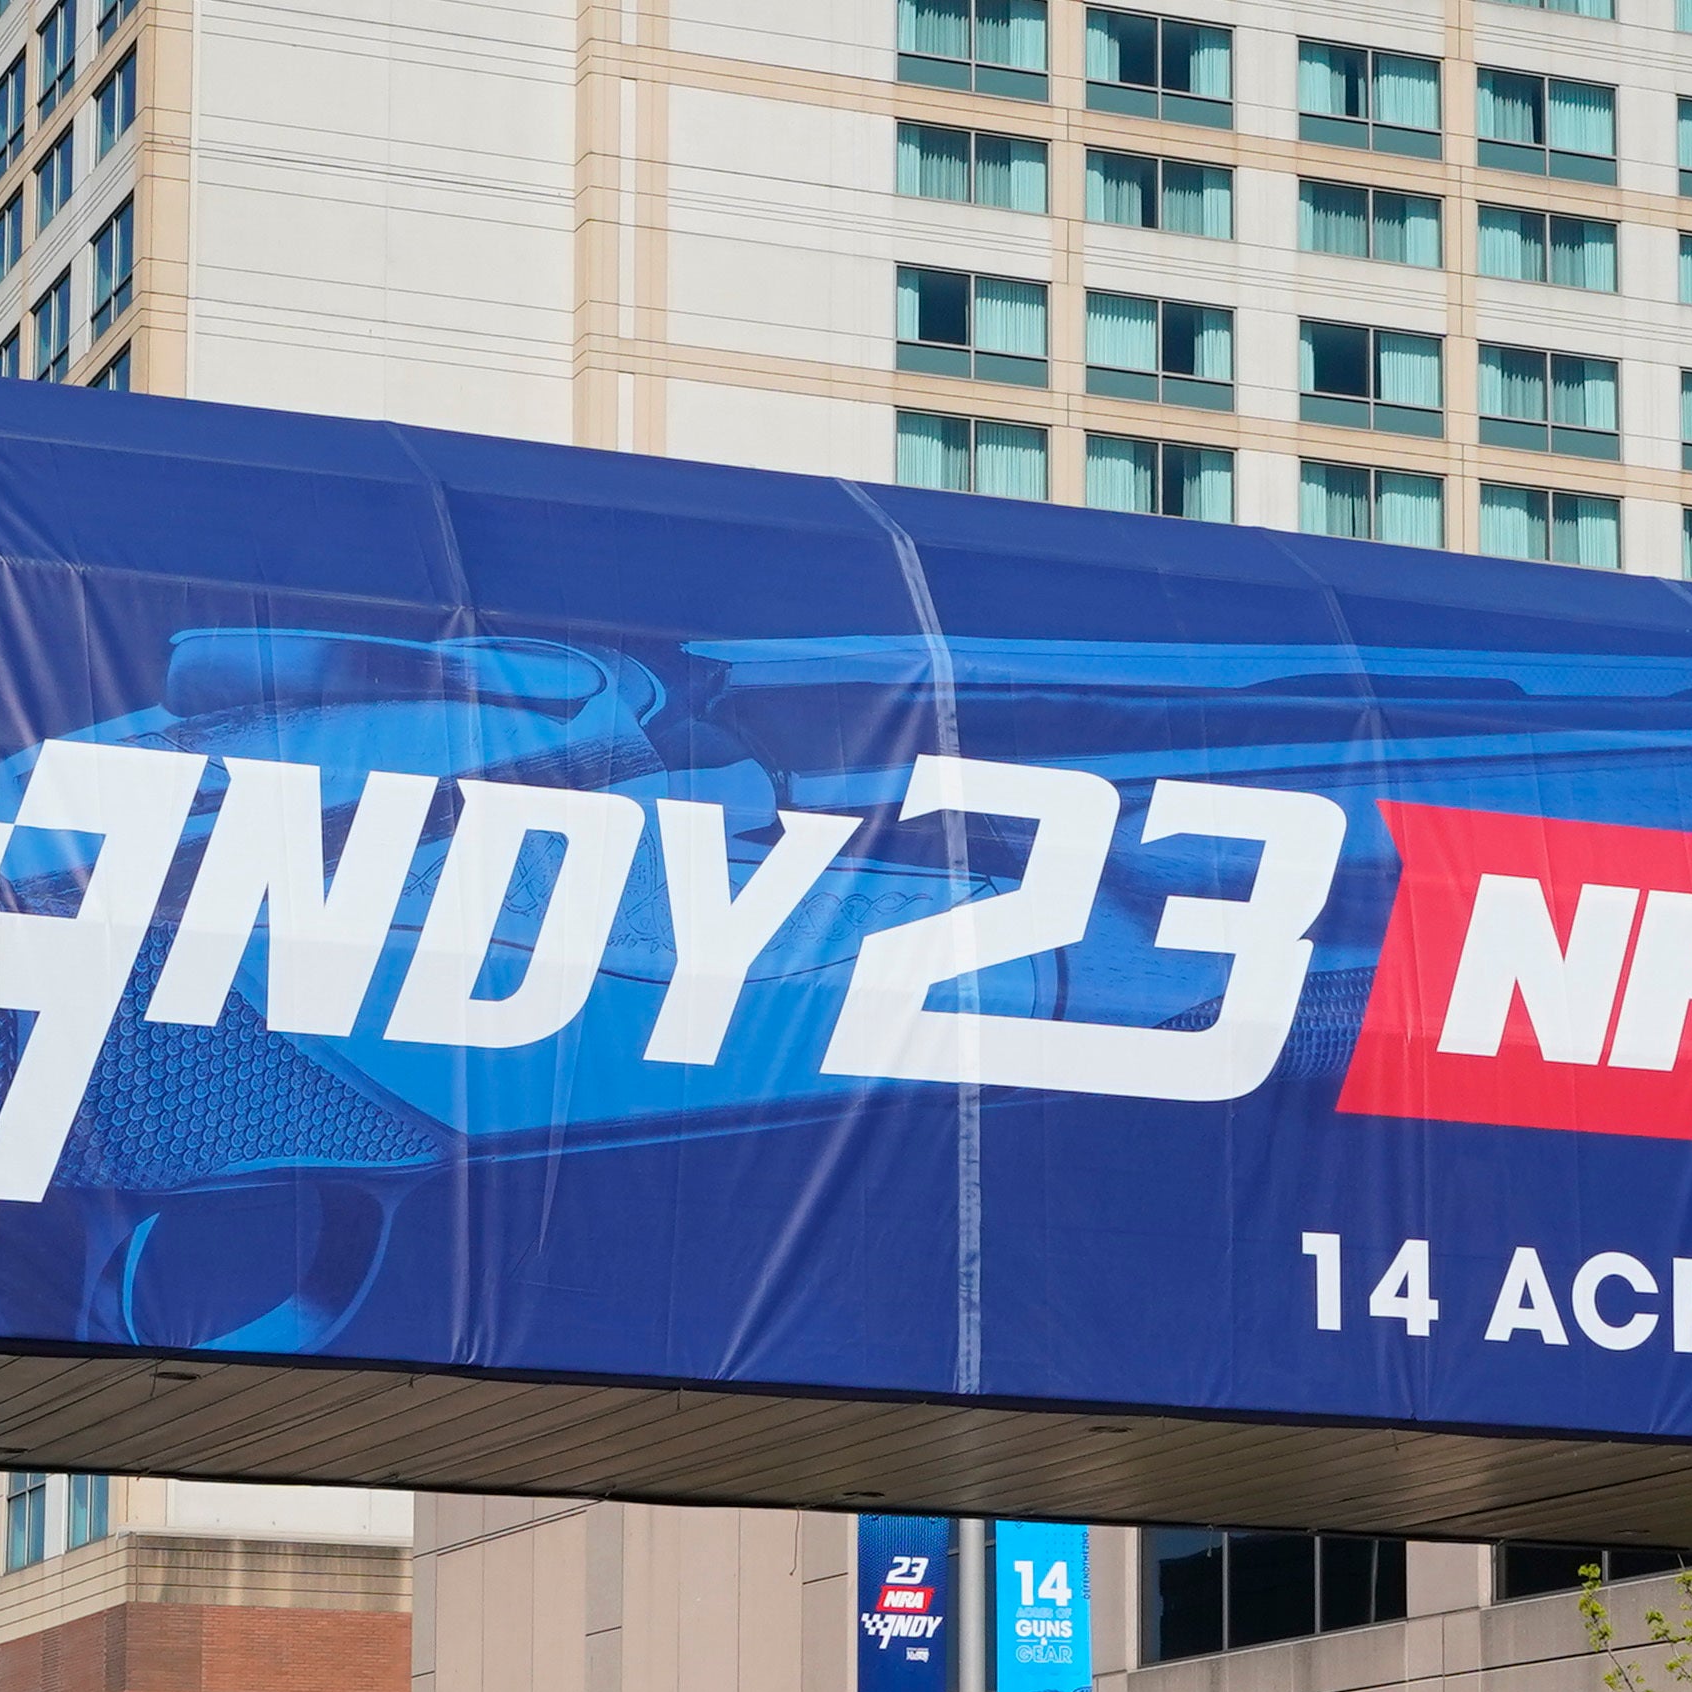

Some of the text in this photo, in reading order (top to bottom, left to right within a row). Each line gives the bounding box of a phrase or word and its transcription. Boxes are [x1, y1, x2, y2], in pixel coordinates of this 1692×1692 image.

[821, 754, 1345, 1101] 23
[1302, 1231, 1439, 1338] 14
[886, 1556, 929, 1584] 23
[1014, 1560, 1072, 1607] 14
[883, 1590, 925, 1609] NRA
[1015, 1620, 1072, 1638] GUNS
[1015, 1645, 1073, 1664] GEAR
